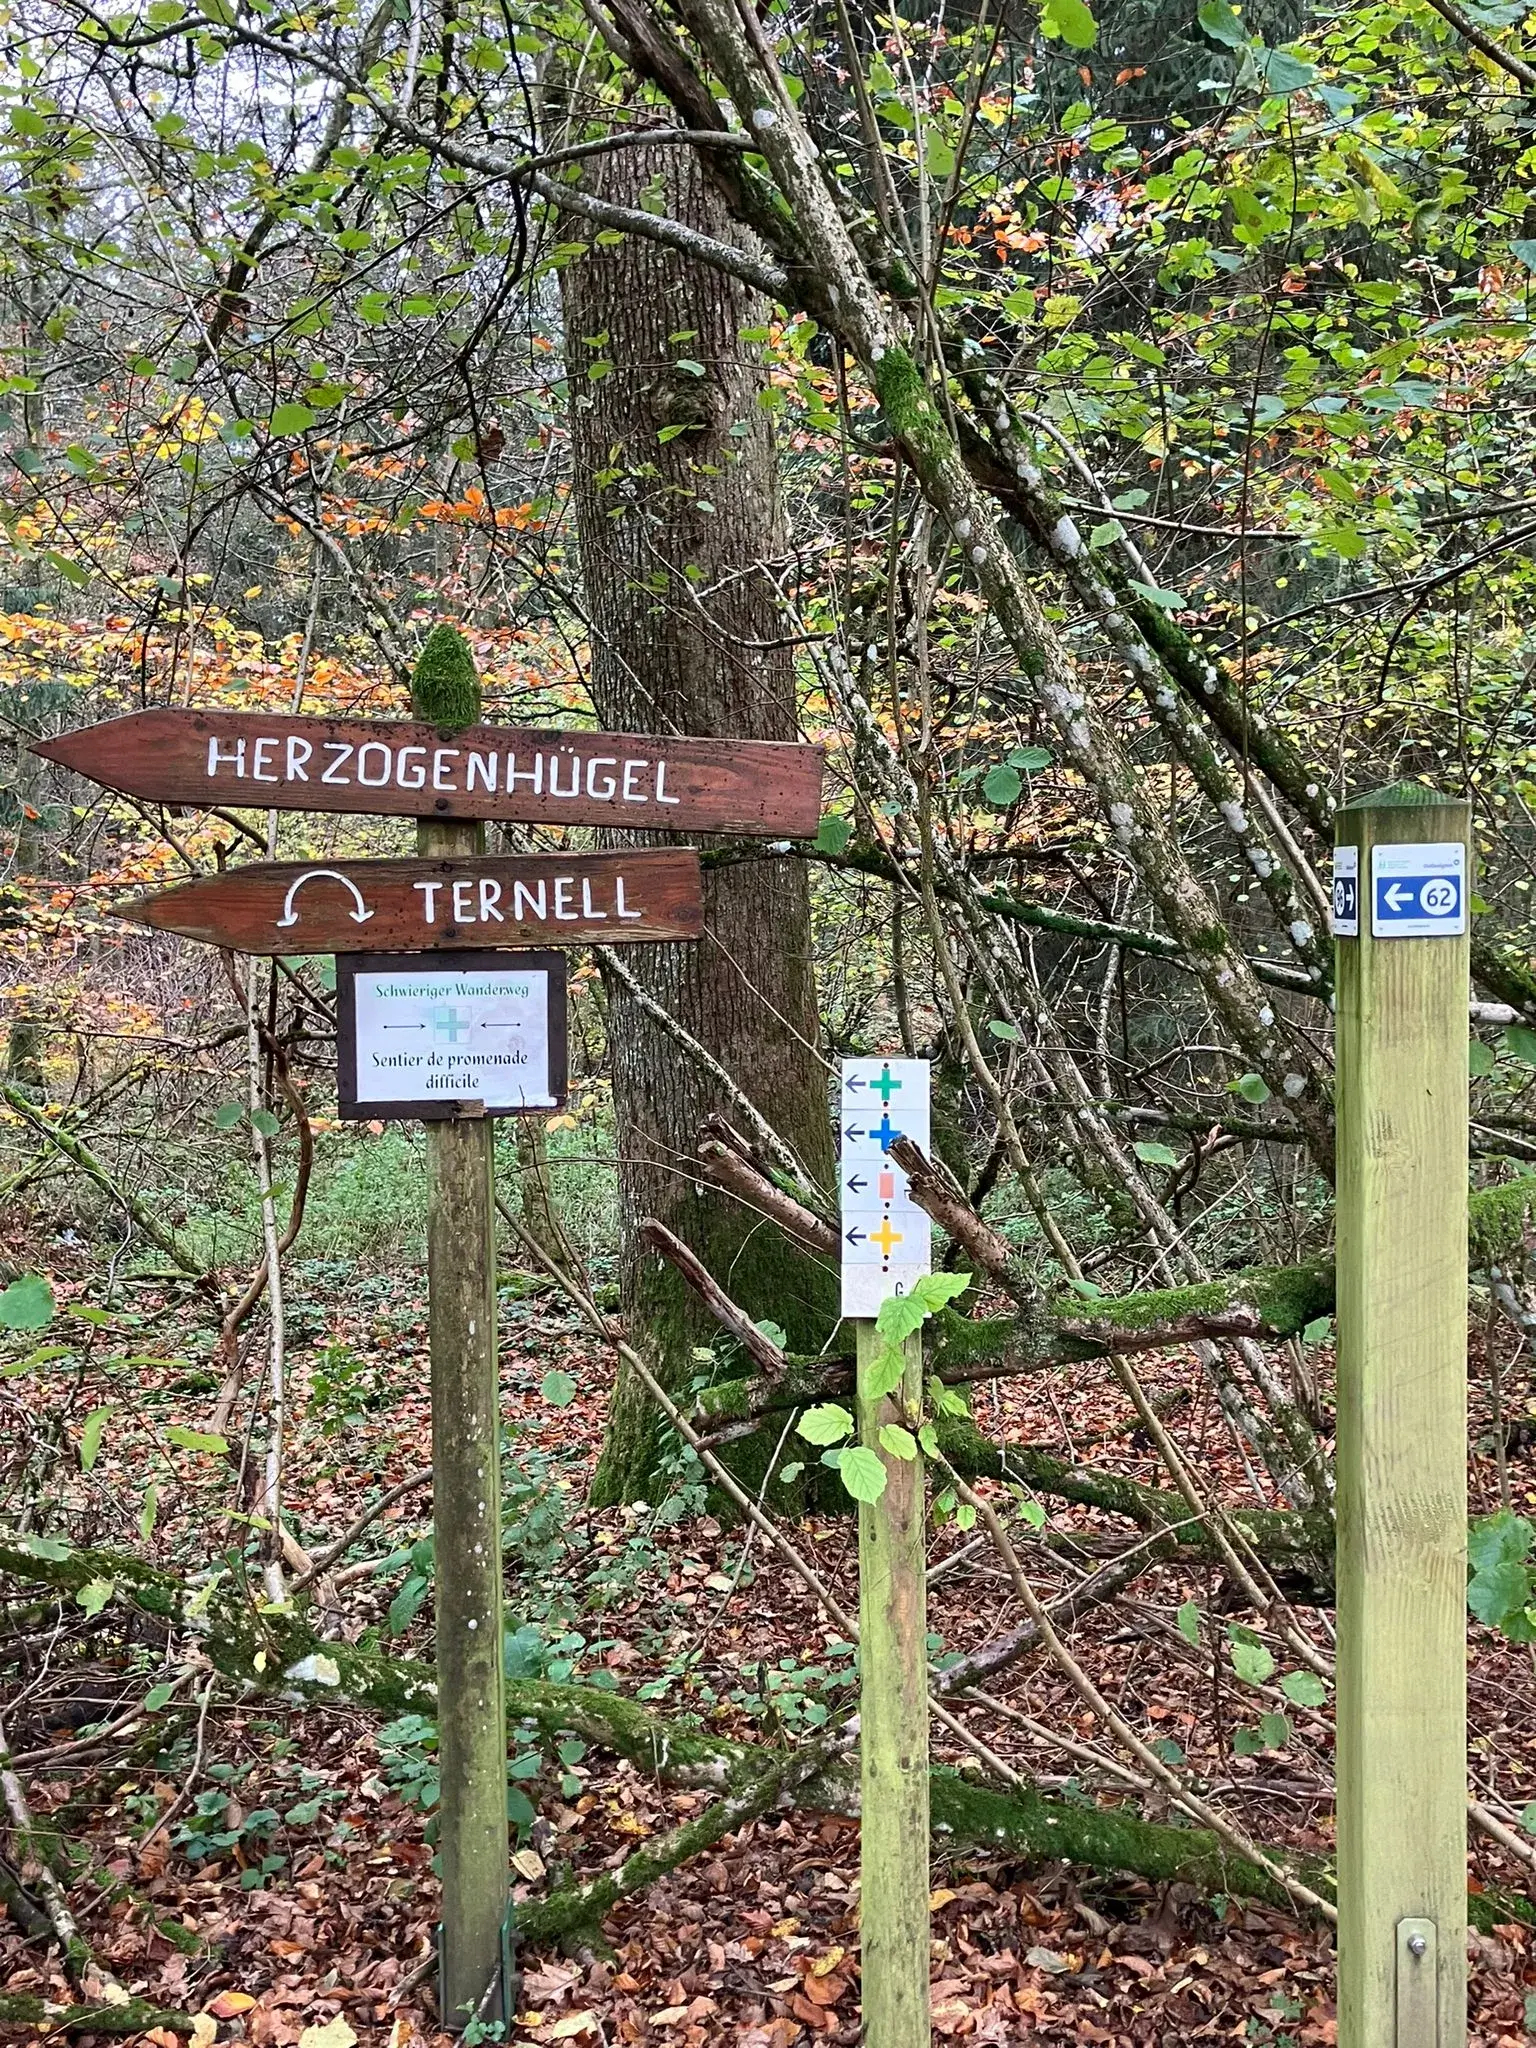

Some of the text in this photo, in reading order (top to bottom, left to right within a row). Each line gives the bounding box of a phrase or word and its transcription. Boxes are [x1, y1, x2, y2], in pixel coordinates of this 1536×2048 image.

[207, 735, 681, 805] HERZOGENHÜGEL
[413, 875, 642, 925] TERNELL
[1427, 887, 1451, 907] 62
[376, 983, 529, 999] Schwieriger Wanderweg
[372, 1050, 528, 1069] Sentier de promenade
[426, 1074, 479, 1089] difficile
